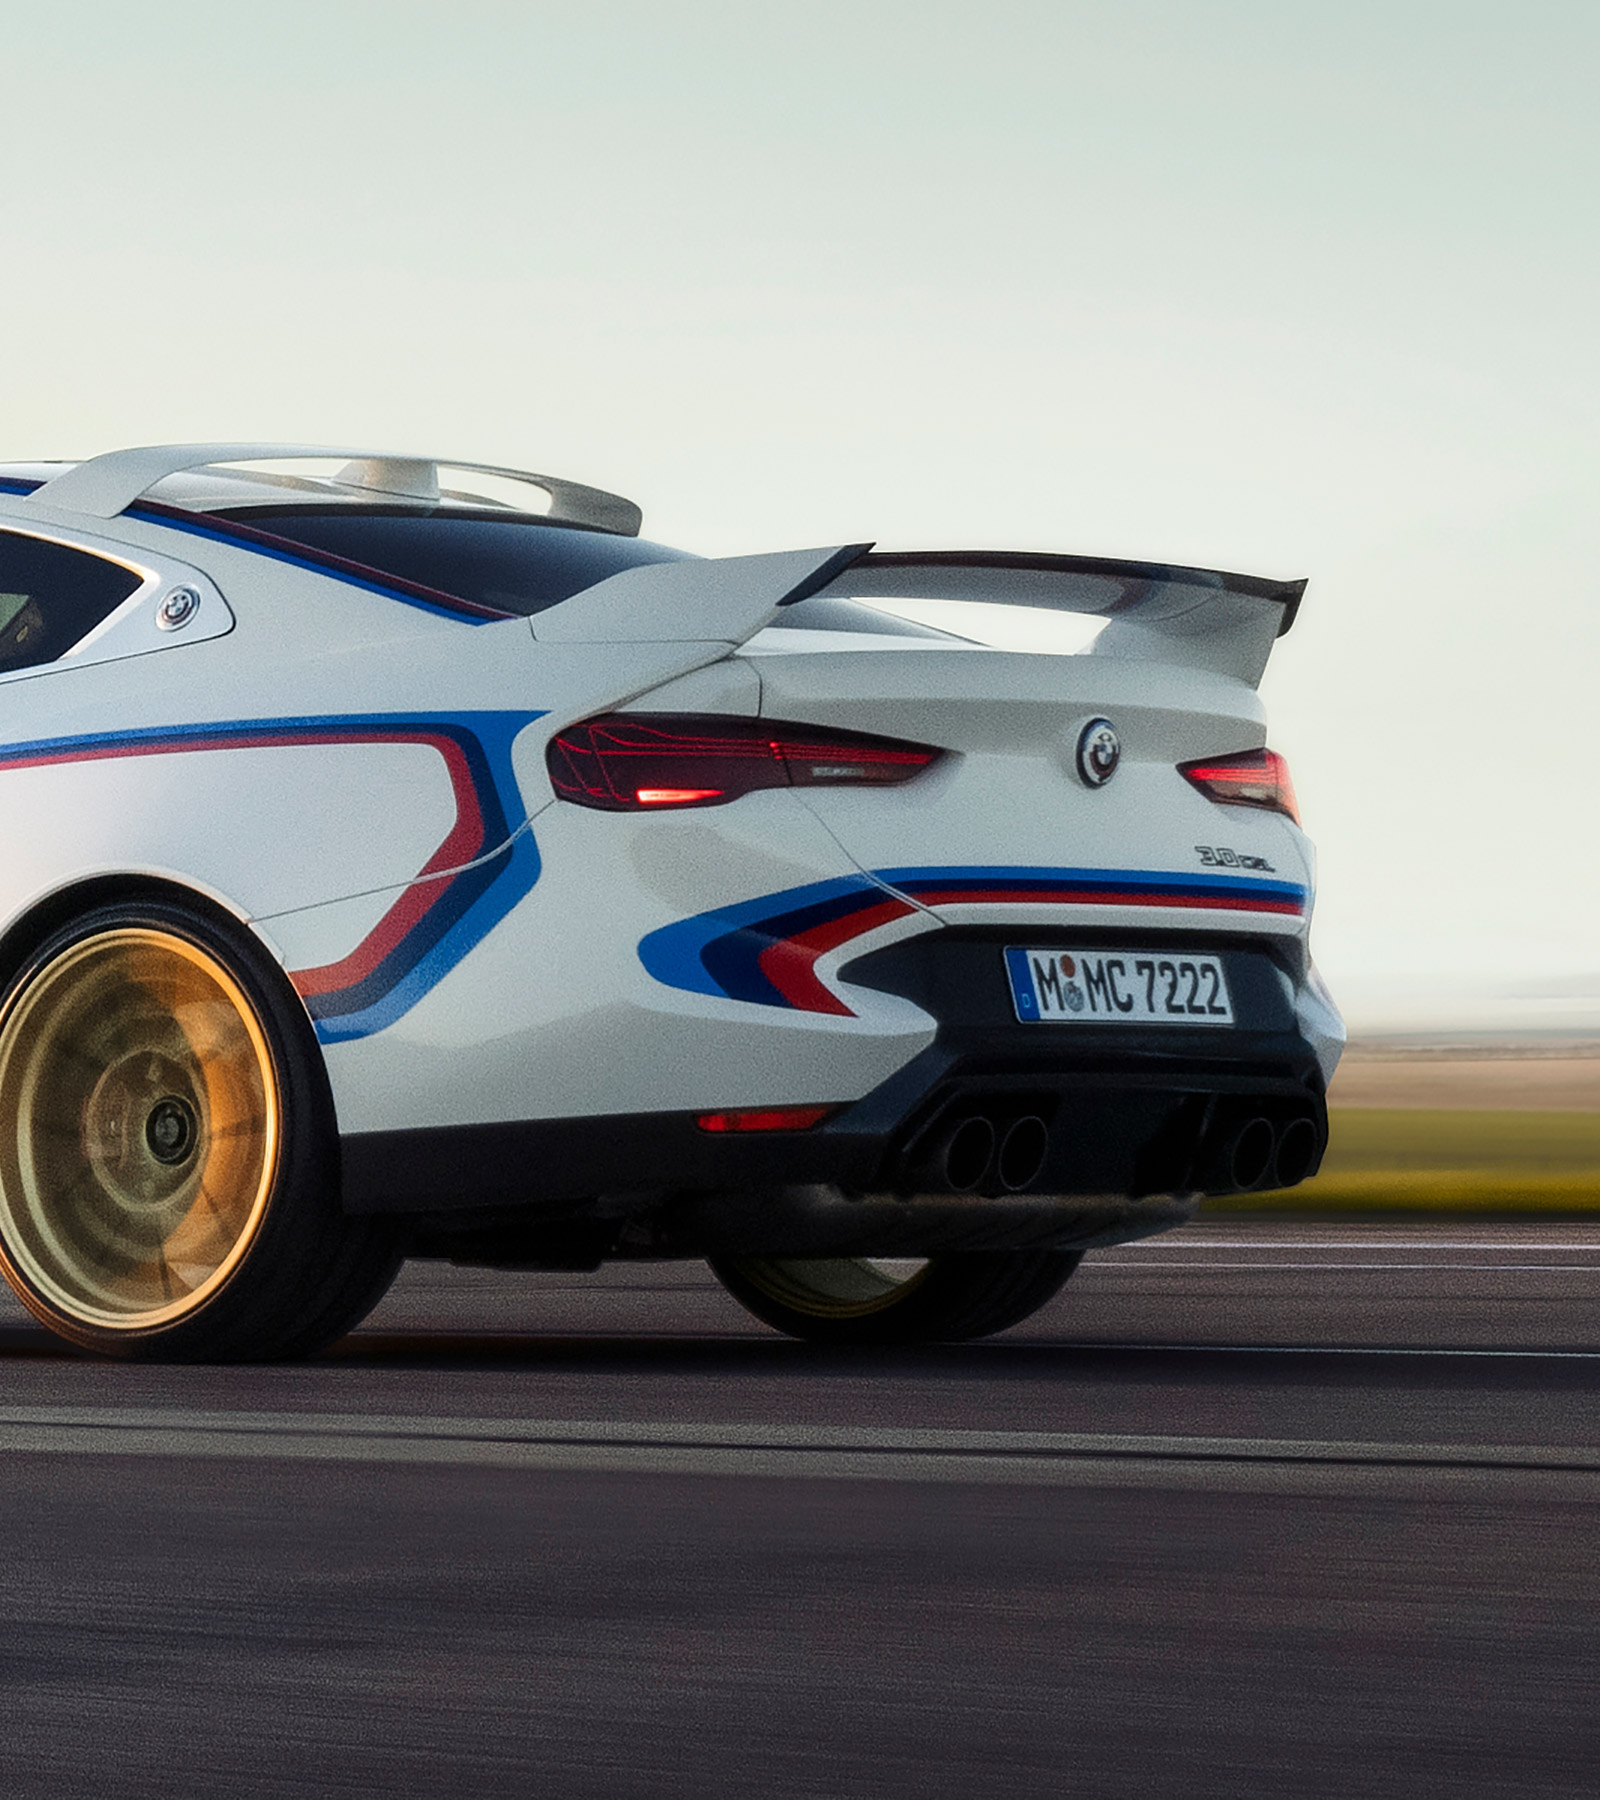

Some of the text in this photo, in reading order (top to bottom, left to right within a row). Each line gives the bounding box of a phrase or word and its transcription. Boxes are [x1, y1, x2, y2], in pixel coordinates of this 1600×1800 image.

[1033, 957, 1227, 1015] M MC 7222
